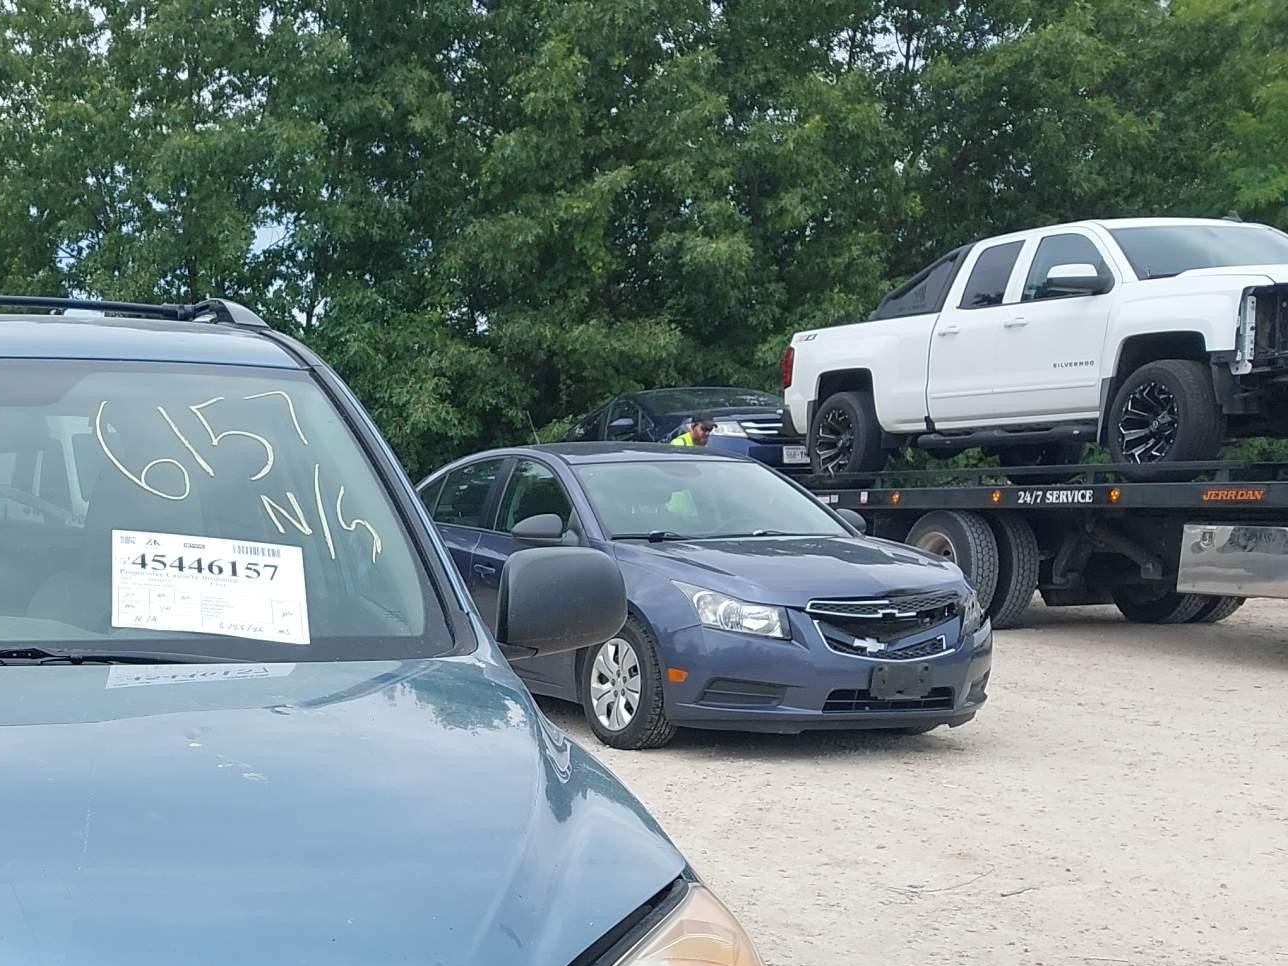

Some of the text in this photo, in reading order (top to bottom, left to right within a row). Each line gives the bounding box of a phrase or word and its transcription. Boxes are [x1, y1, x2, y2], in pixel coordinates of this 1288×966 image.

[95, 390, 309, 501] 6157
[1017, 489, 1094, 505] 24/7 SERVICE
[131, 552, 280, 582] 45446157
